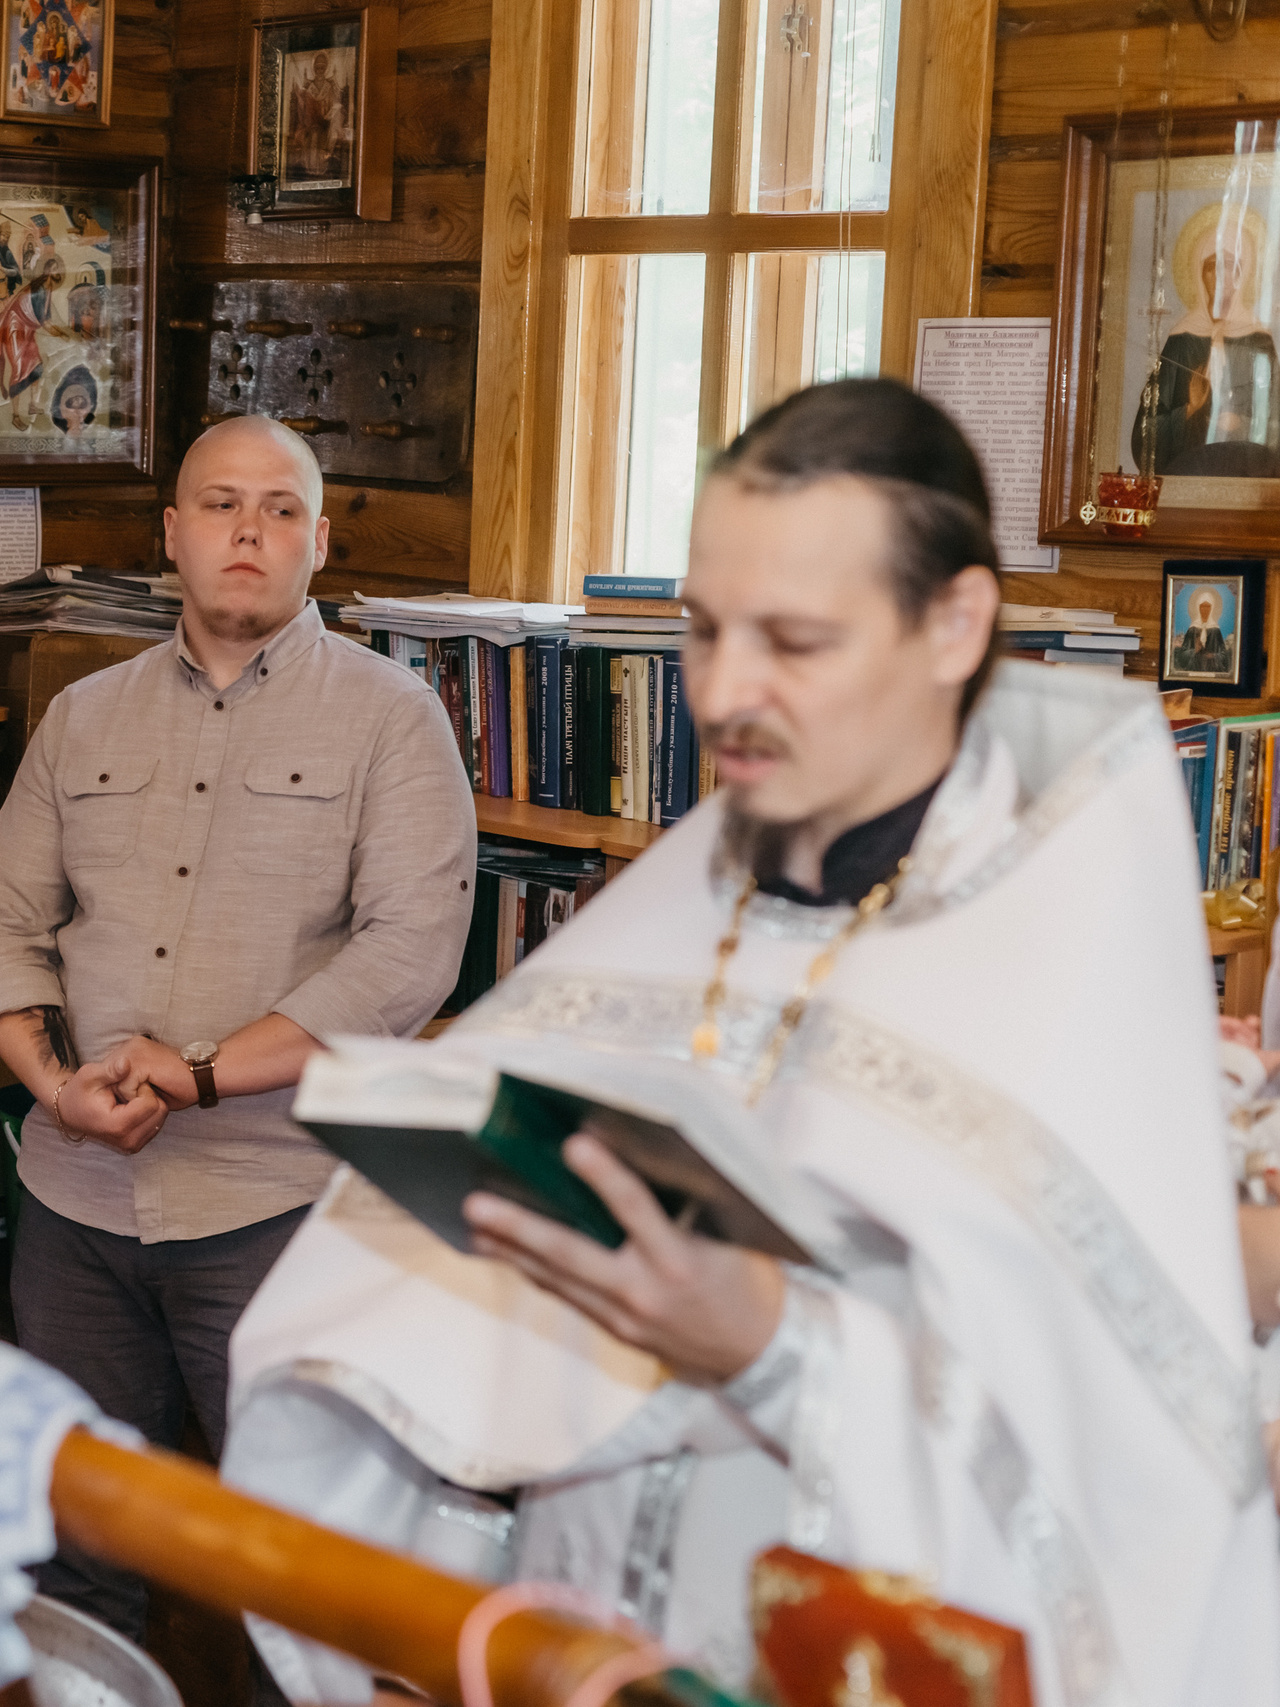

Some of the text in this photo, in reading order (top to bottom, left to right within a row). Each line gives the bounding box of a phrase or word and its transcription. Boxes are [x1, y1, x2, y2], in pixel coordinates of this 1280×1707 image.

[984, 340, 1033, 348] Московской
[628, 584, 662, 592] НЕВИДИМЫЙ
[565, 665, 574, 700] ПТИЦЫ
[564, 702, 572, 738] ТРЕТЬЕЙ
[666, 750, 674, 806] Богослужебные
[670, 685, 678, 704] 2010
[1225, 750, 1234, 789] времен
